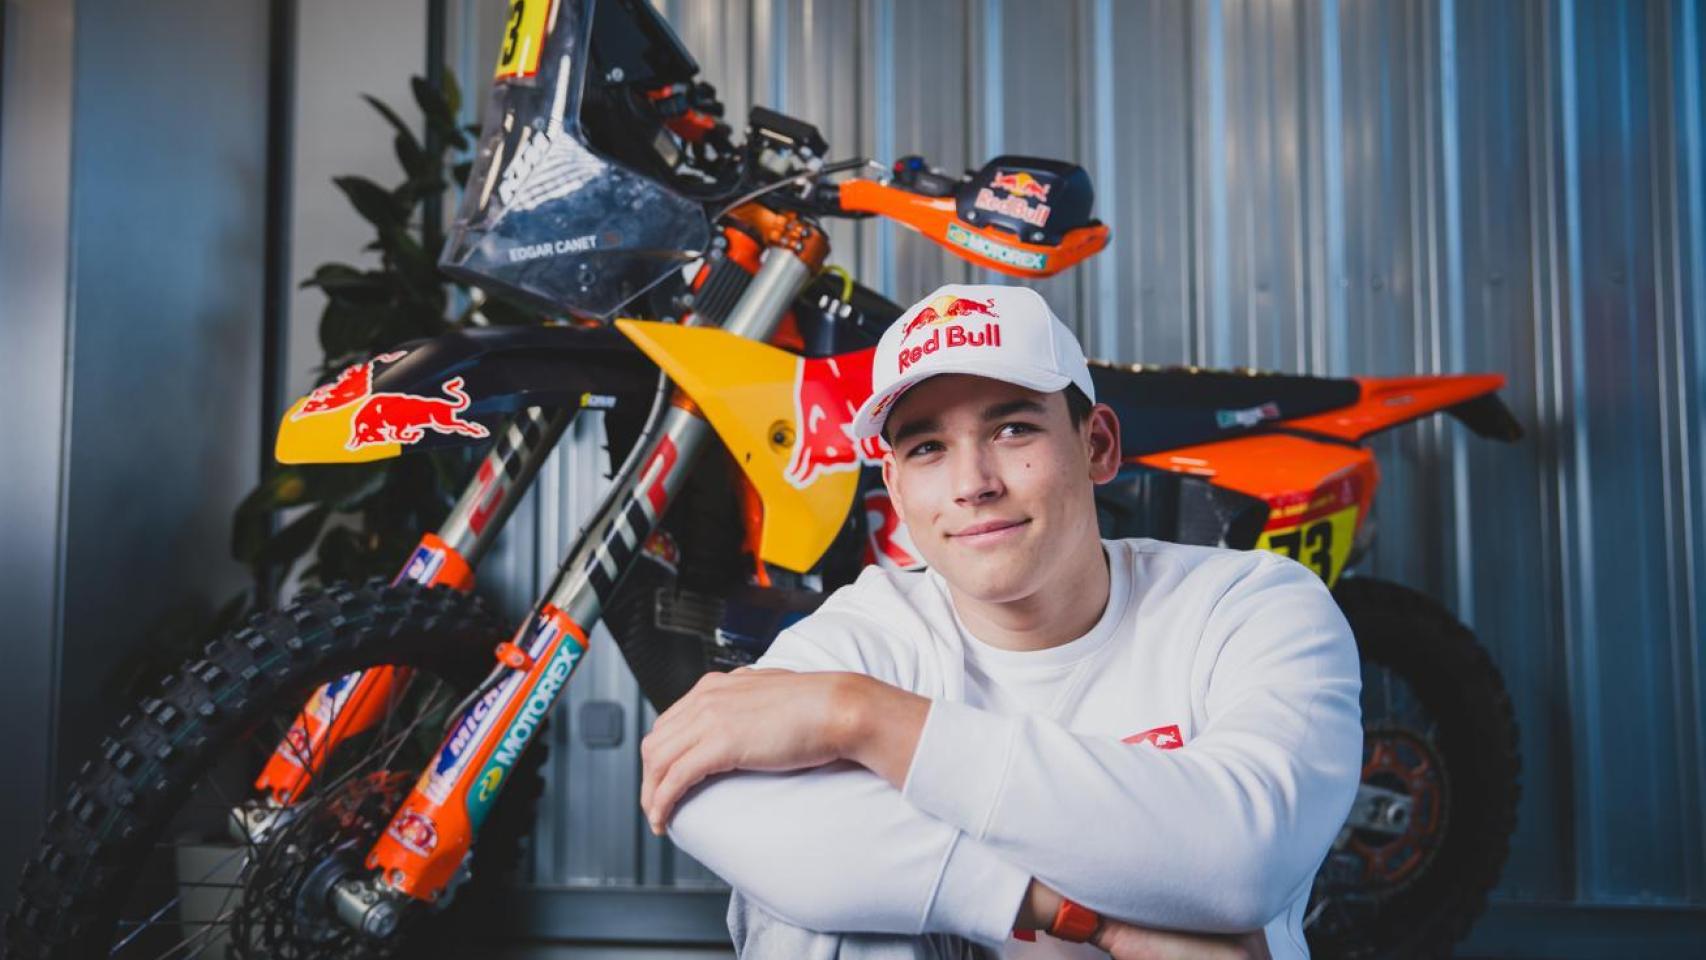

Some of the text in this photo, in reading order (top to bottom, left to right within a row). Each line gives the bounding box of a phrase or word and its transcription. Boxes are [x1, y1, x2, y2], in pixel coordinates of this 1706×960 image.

[509, 235, 597, 262] EDGAR CANET
[898, 323, 1001, 374] Red Bull
[1269, 521, 1334, 586] 73
[496, 645, 580, 766] MOTOREX
